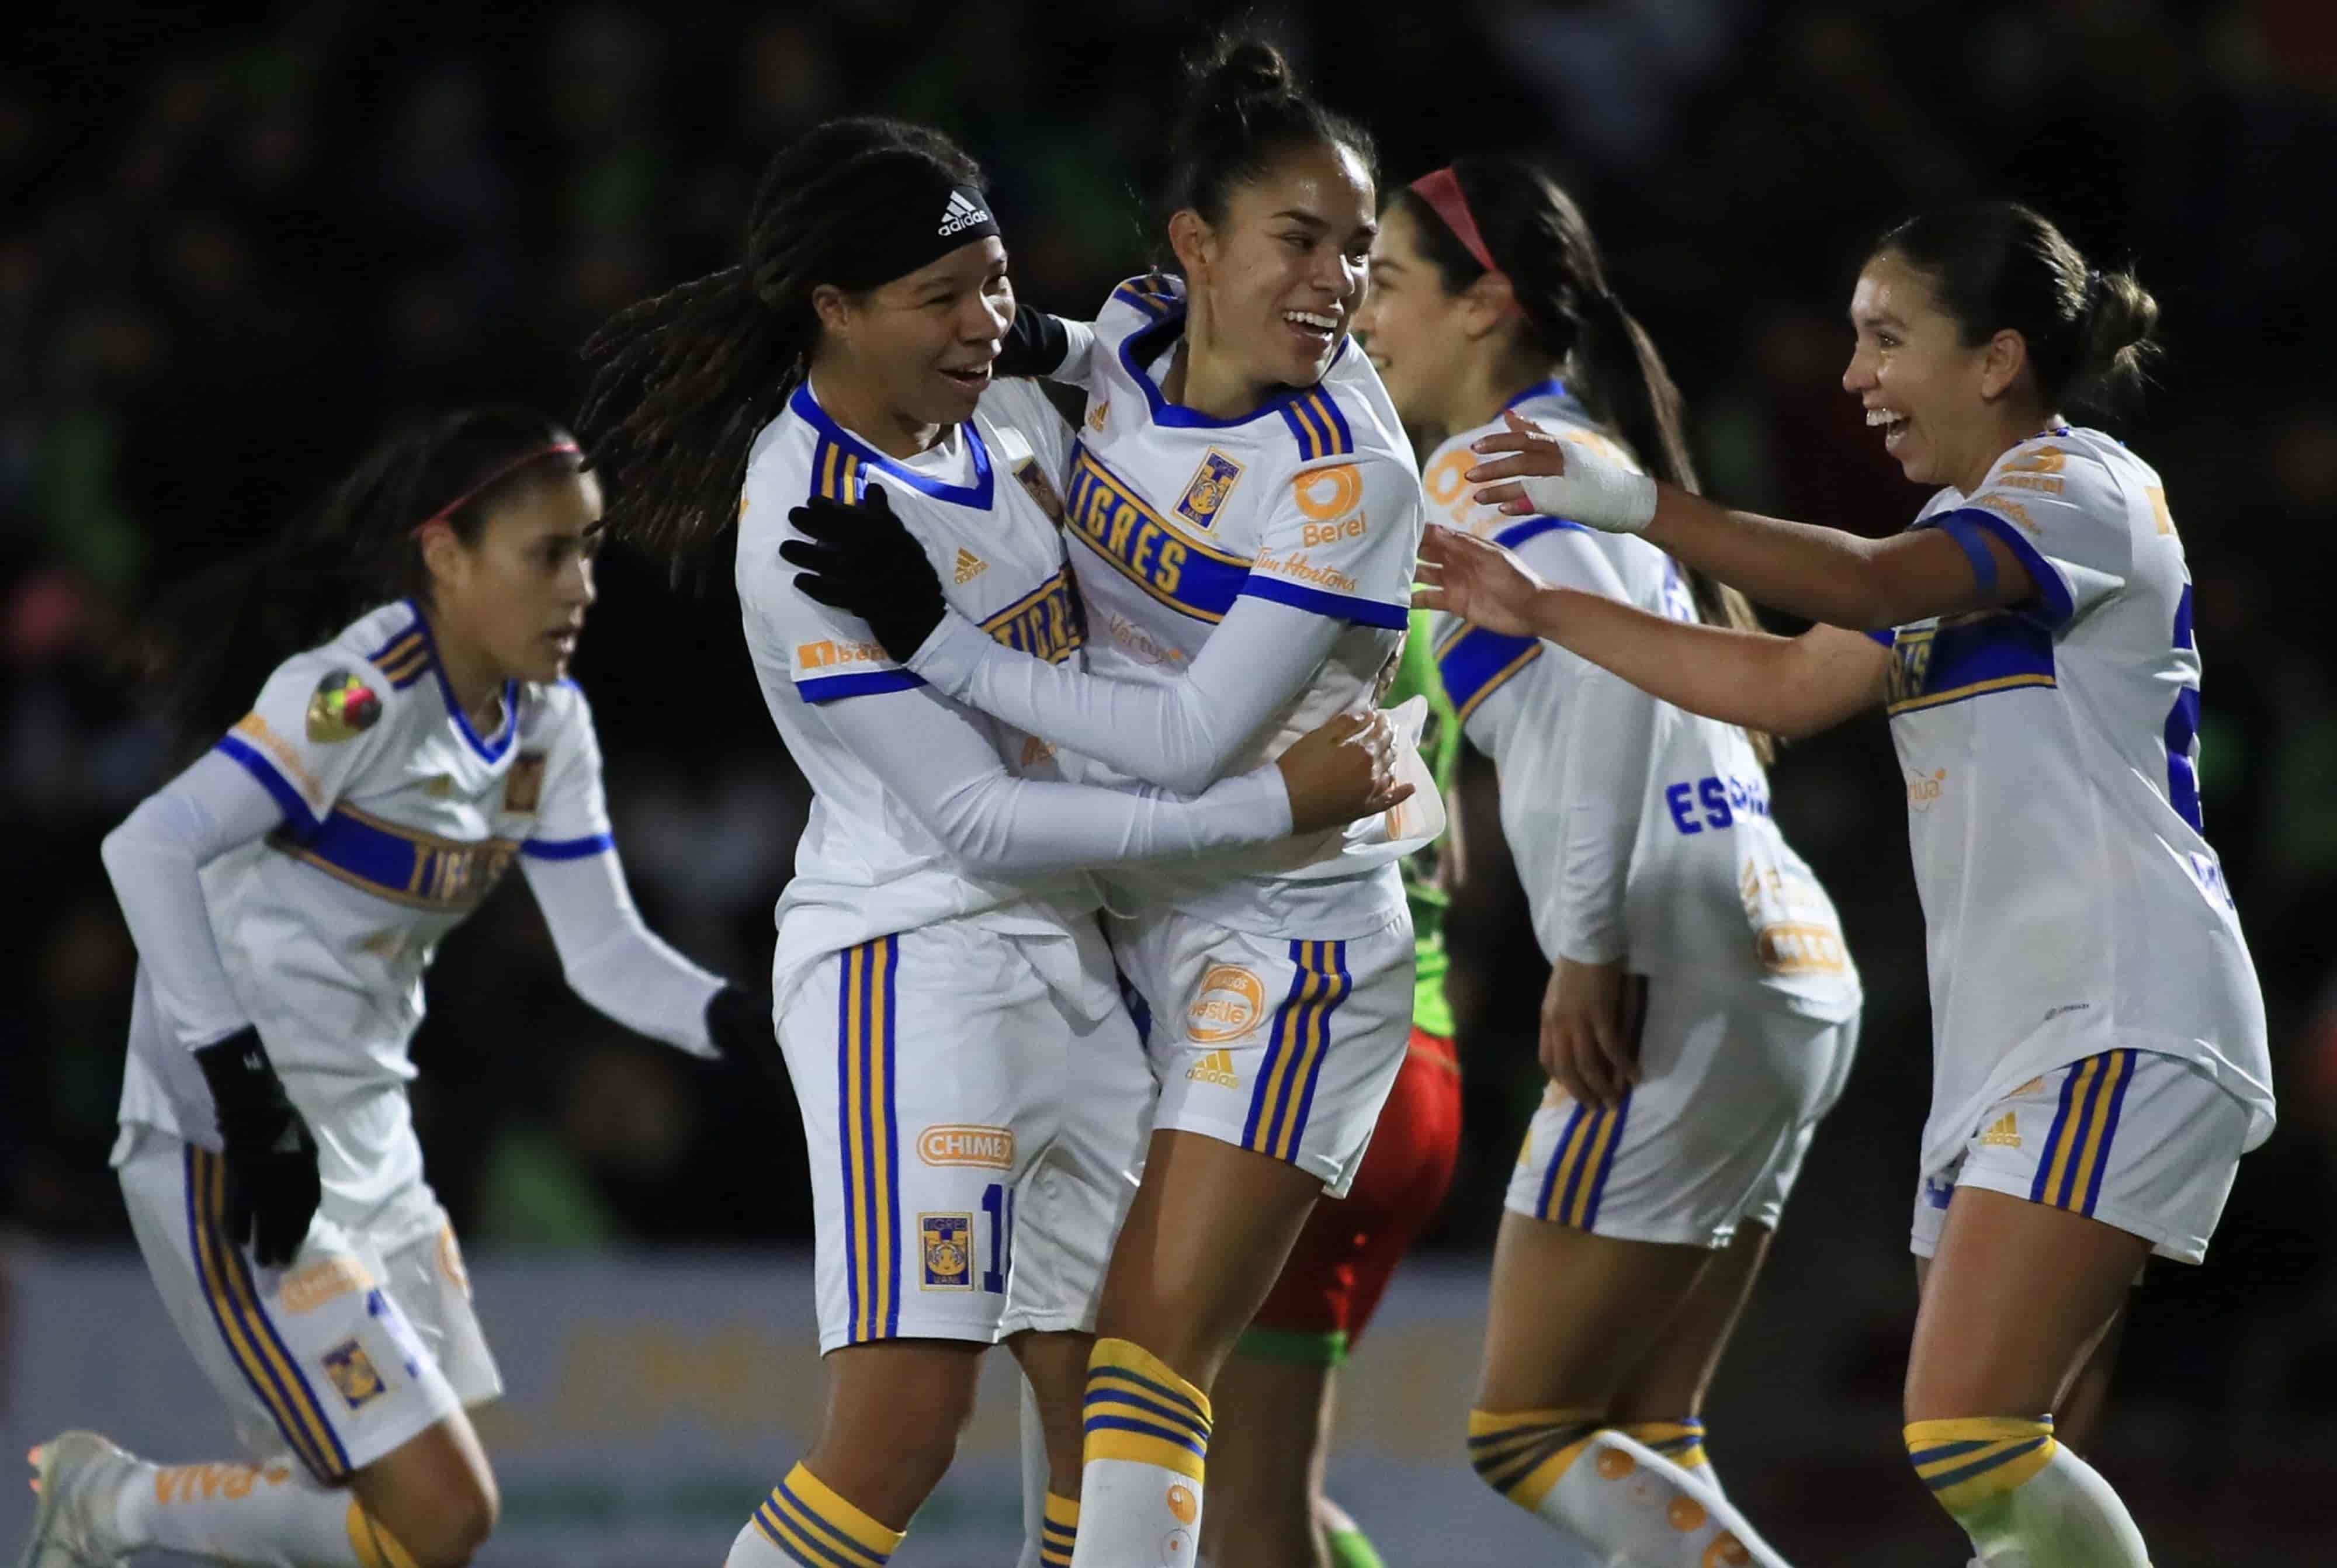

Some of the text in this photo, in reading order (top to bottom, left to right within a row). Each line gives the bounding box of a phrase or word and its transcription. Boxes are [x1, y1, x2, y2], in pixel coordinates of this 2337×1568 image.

[938, 210, 988, 236] adidas
[1067, 459, 1187, 593] IGRES
[1303, 510, 1367, 548] Berel
[1256, 547, 1357, 591] Tim Hortons
[1185, 1067, 1240, 1090] adidas
